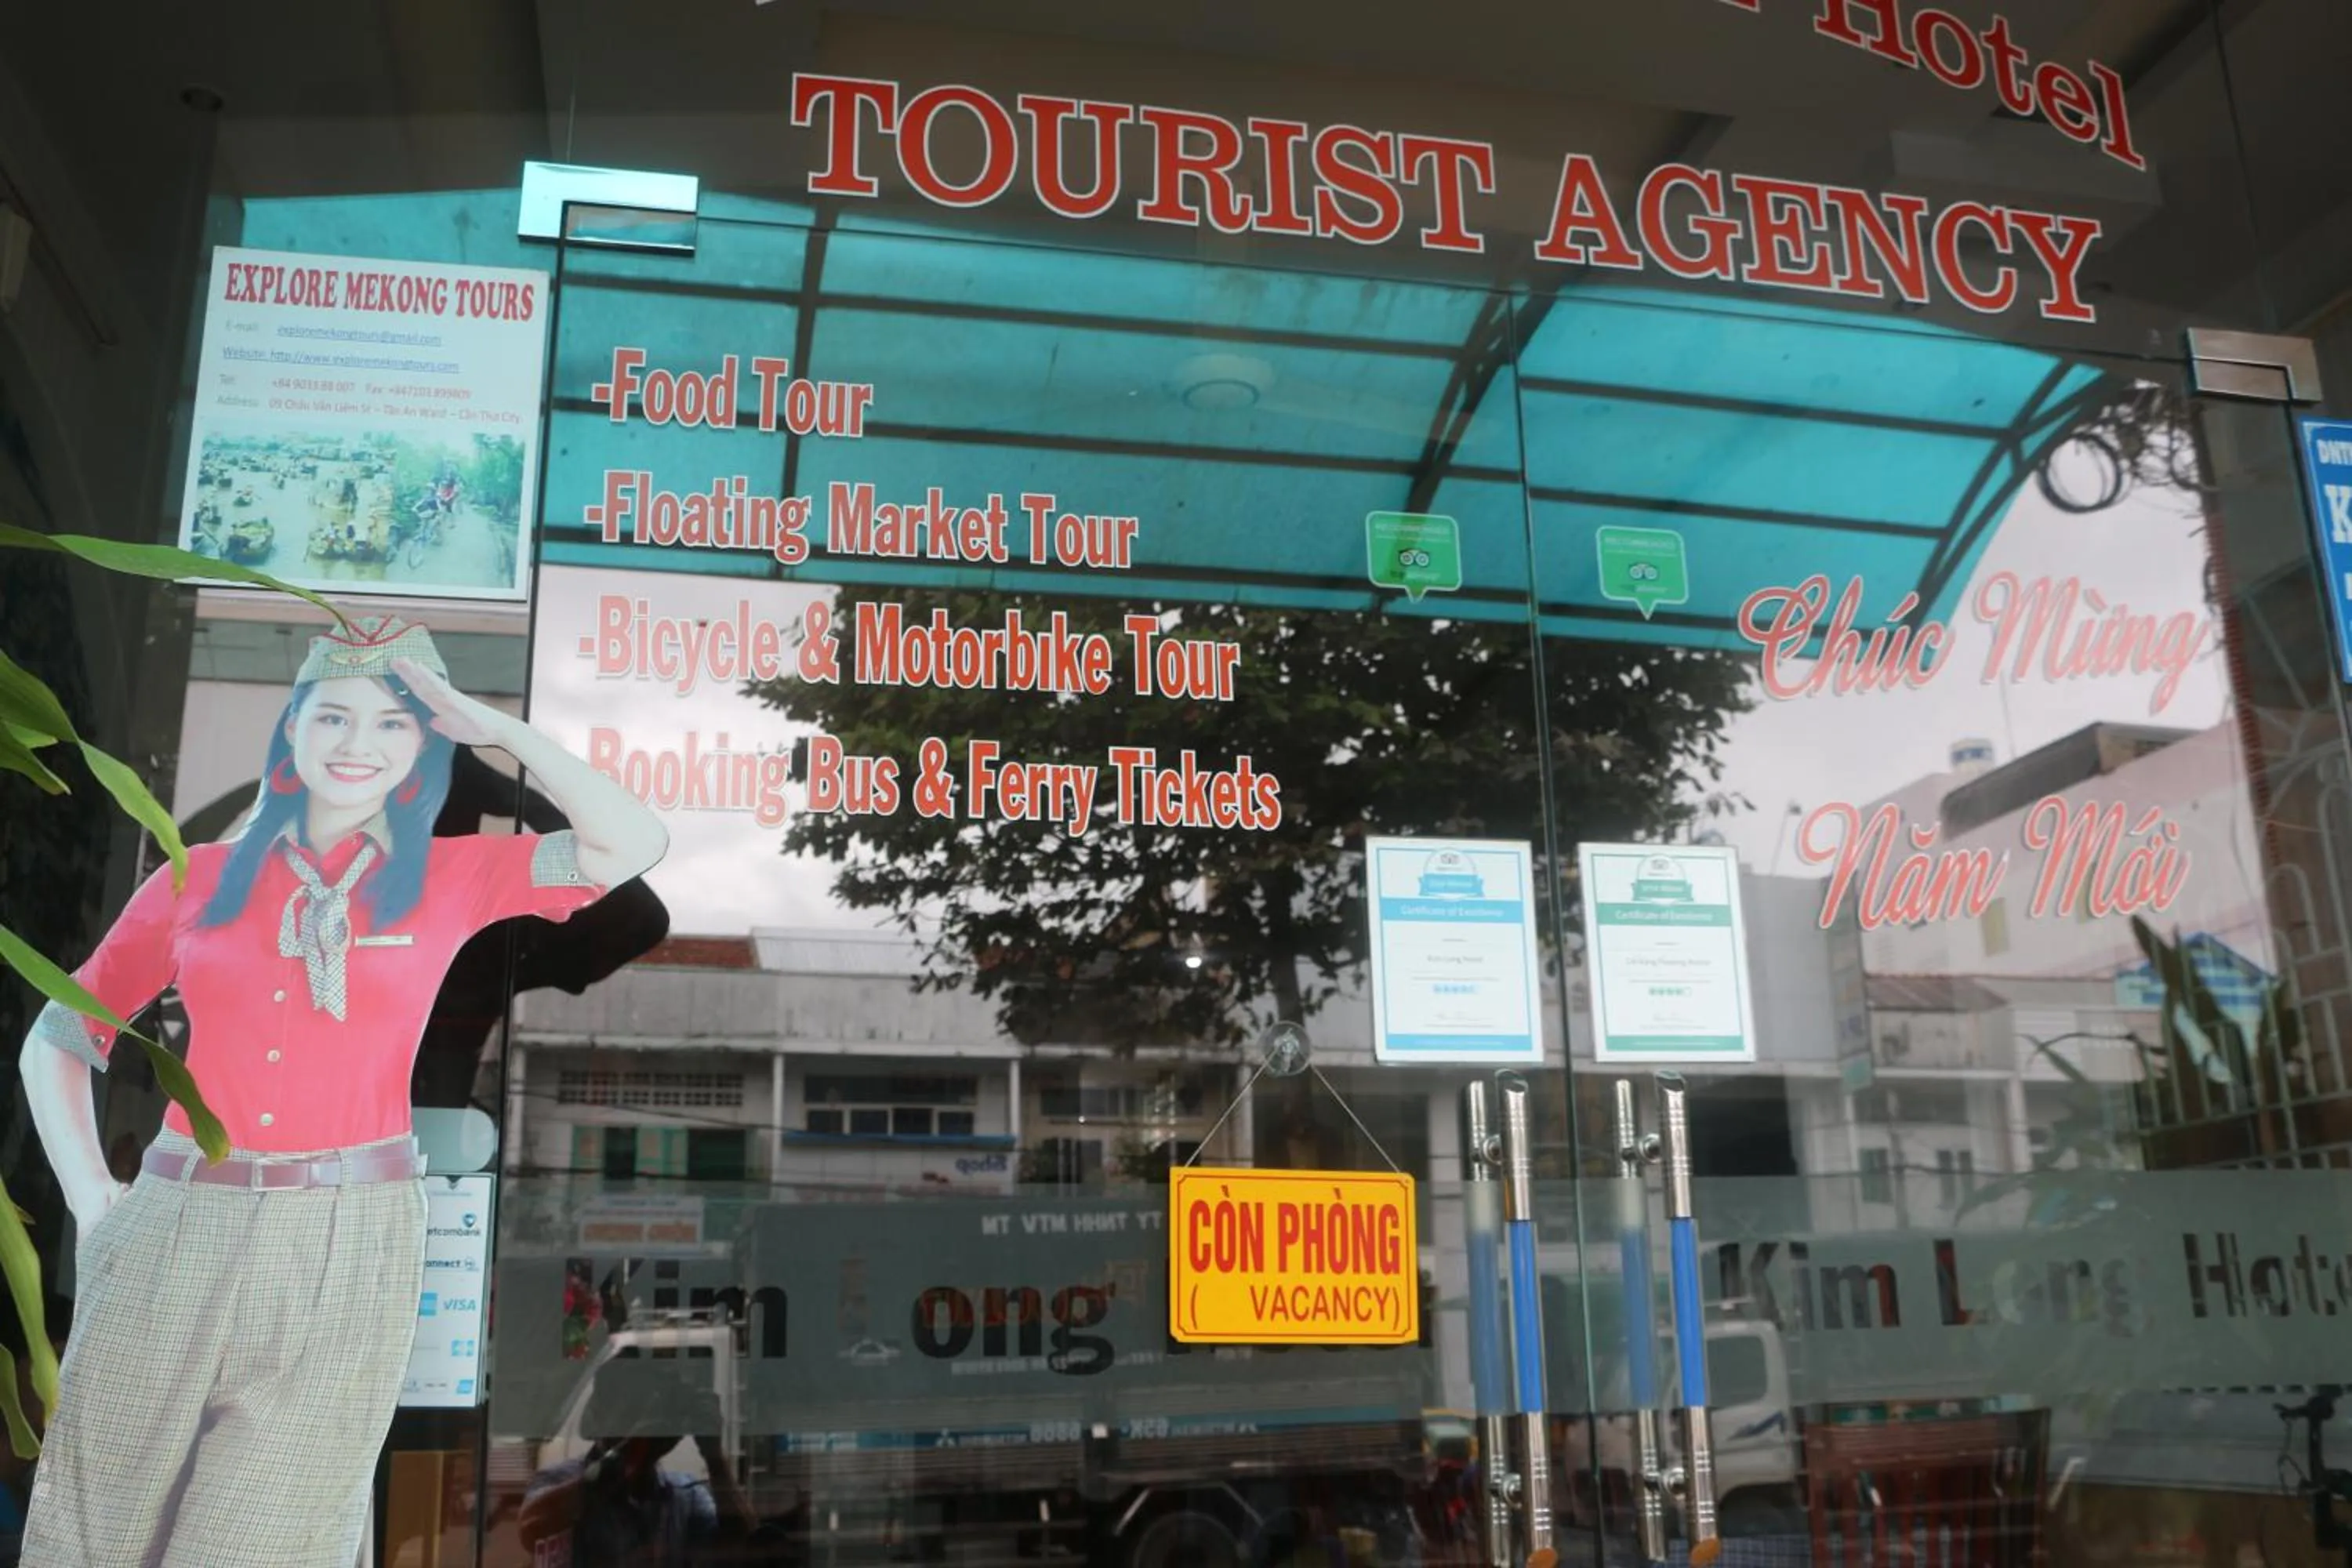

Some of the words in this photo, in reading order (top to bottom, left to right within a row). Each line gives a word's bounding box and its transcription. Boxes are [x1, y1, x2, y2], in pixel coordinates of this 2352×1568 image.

[790, 73, 1496, 254] TOURIST
[1534, 152, 2103, 322] AGENCY
[224, 263, 339, 308] EXPLORE
[343, 272, 448, 316] MEKONG
[455, 278, 535, 321] TOURS
[751, 356, 873, 438] Tour
[827, 481, 1009, 562] Market
[1020, 493, 1139, 570] Tour
[797, 600, 840, 684] &
[855, 601, 1113, 696] Motorbike
[1123, 614, 1242, 702] Tour
[806, 734, 900, 817] Bus
[913, 737, 953, 819] &
[968, 739, 1097, 839] Ferry
[1108, 746, 1282, 831] Tickets
[1189, 1185, 1265, 1274] CÒN
[1277, 1187, 1401, 1276] PHÒNG
[443, 1298, 477, 1312] VISA
[561, 1258, 789, 1360] Kim
[1717, 1240, 1901, 1330] Kim
